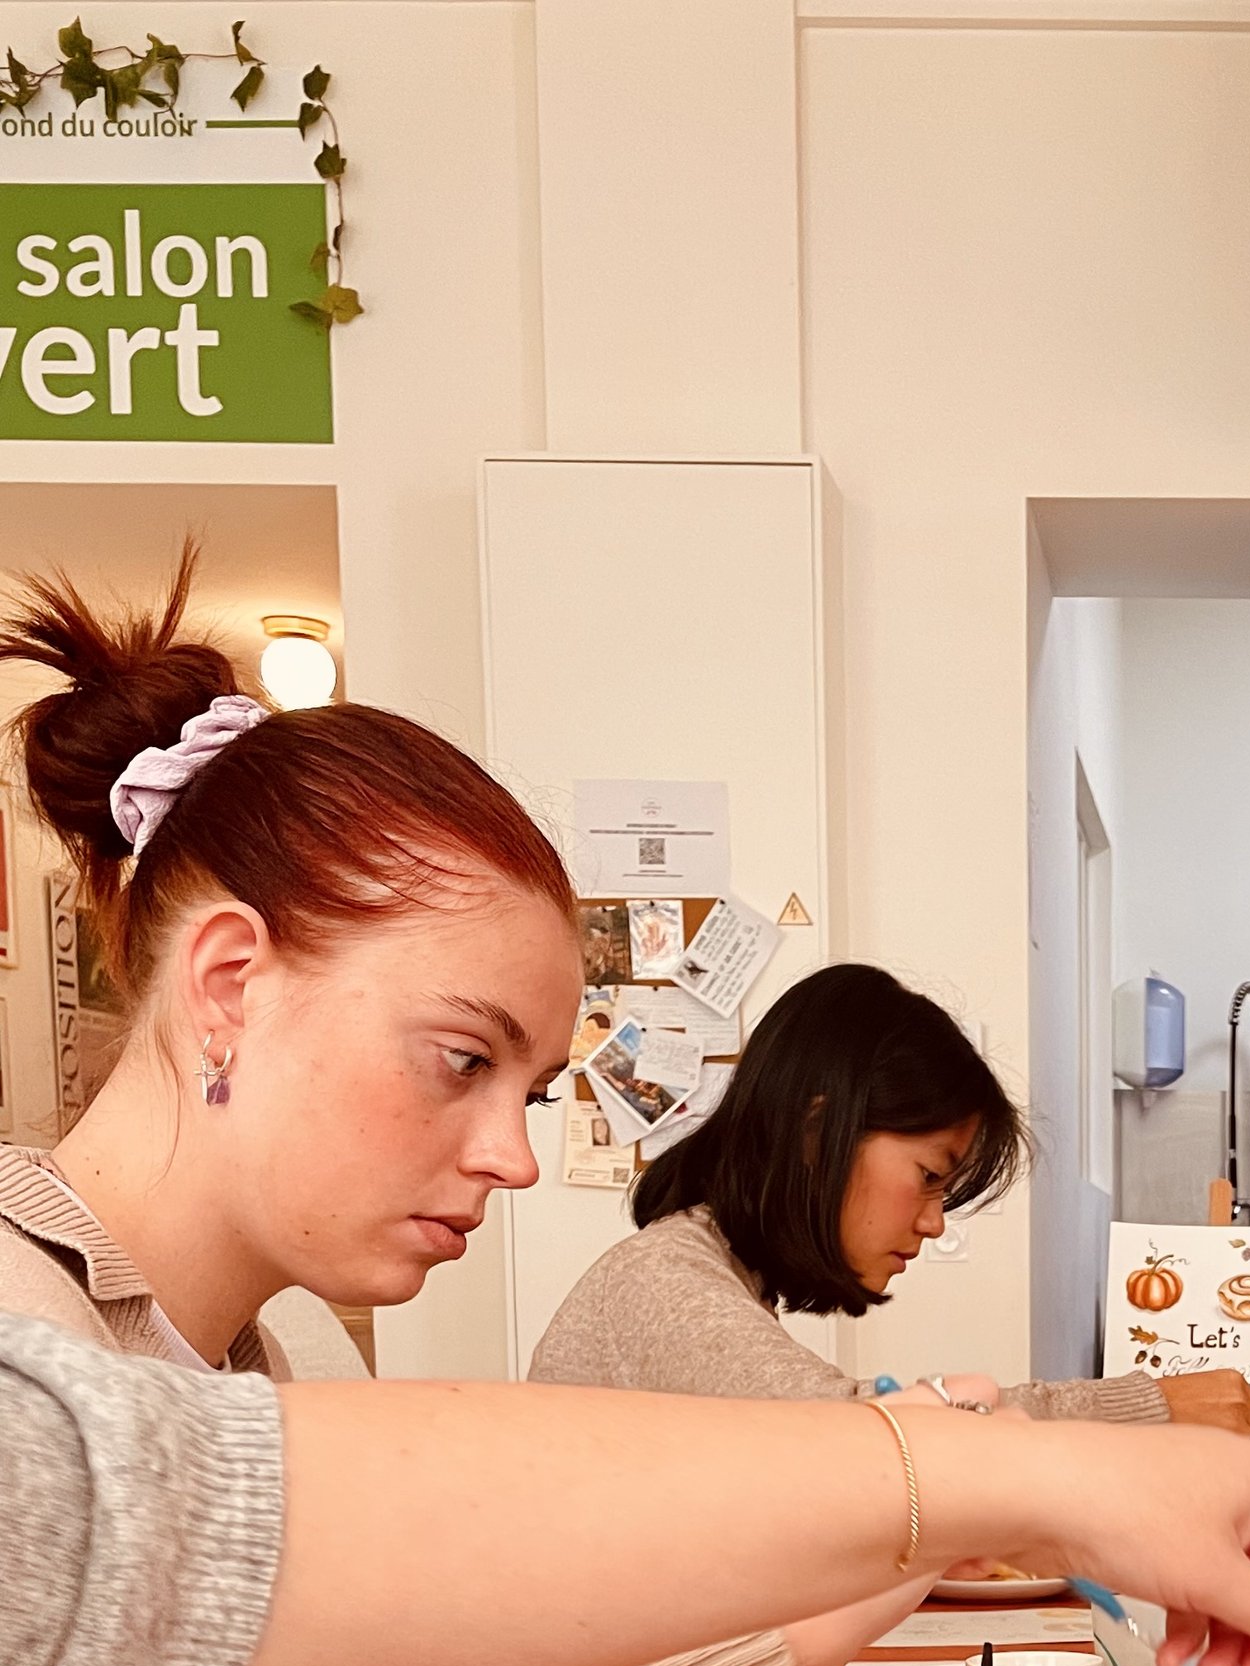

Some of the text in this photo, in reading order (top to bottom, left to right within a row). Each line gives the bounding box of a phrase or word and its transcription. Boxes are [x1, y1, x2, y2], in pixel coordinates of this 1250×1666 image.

[61, 112, 95, 137] du
[102, 112, 198, 137] couloir
[16, 209, 269, 298] salon
[1187, 1323, 1241, 1348] Let's
